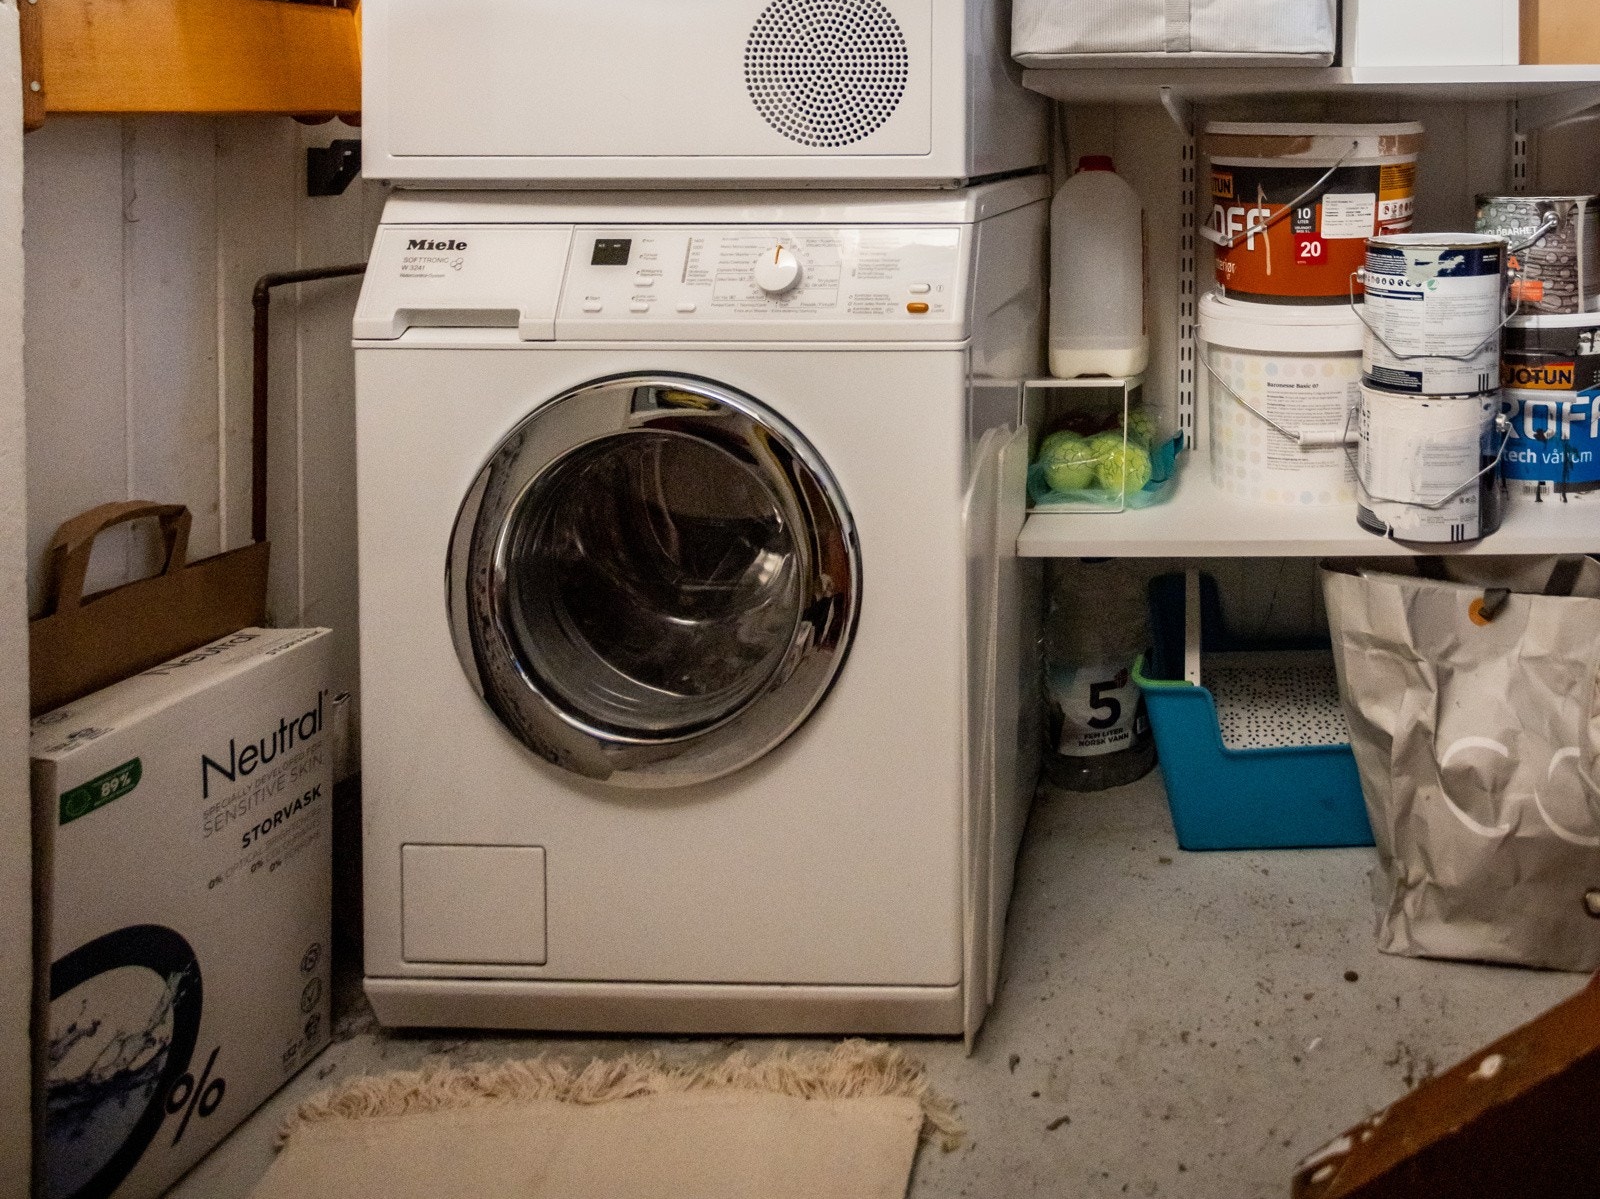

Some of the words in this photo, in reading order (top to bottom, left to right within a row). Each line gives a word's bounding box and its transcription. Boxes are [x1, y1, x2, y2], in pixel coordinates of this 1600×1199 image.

[1297, 208, 1311, 220] 10
[406, 238, 468, 251] Miele
[1300, 241, 1322, 258] 20
[403, 256, 449, 264] SOFTTRONIC
[1507, 368, 1572, 385] JOTUN
[1087, 672, 1124, 730] 5
[202, 689, 324, 800] Neutral
[1078, 737, 1107, 747] NORSK
[1109, 732, 1129, 743] VANN
[203, 773, 286, 839] SENSITIVE
[290, 751, 324, 784] SKIN
[203, 783, 253, 820] SPECIALLY
[241, 782, 322, 850] STORVASK
